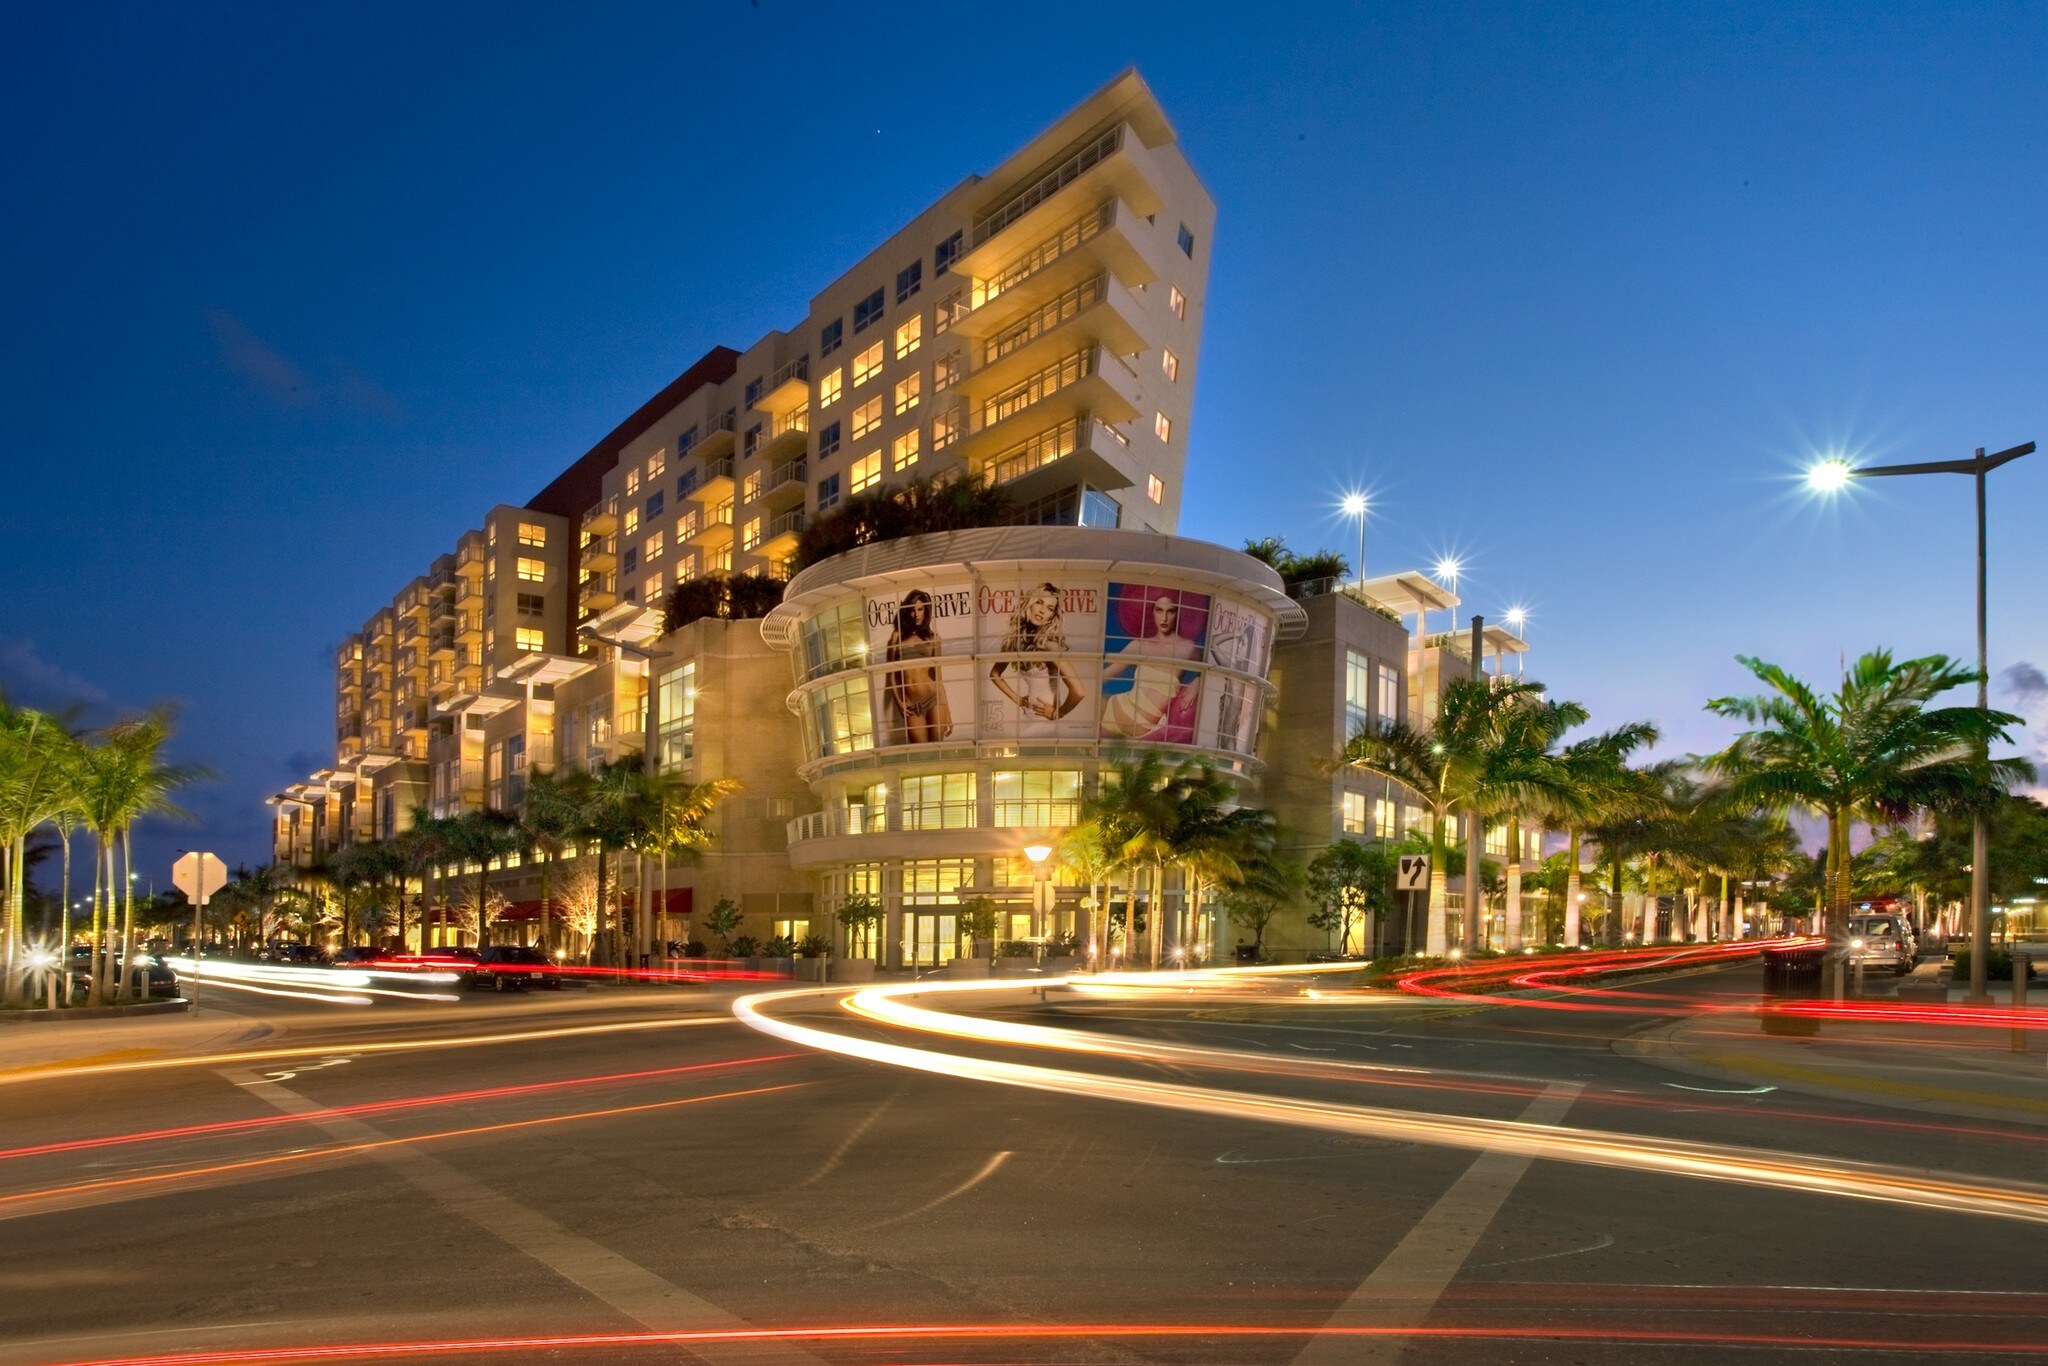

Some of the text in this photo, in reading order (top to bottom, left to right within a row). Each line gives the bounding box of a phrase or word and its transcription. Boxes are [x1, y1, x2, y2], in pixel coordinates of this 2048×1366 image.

[868, 591, 971, 628] OCE RIVE
[978, 585, 1098, 615] OCE RIVE
[980, 703, 1005, 721] 15
[980, 722, 1004, 731] YEARS
